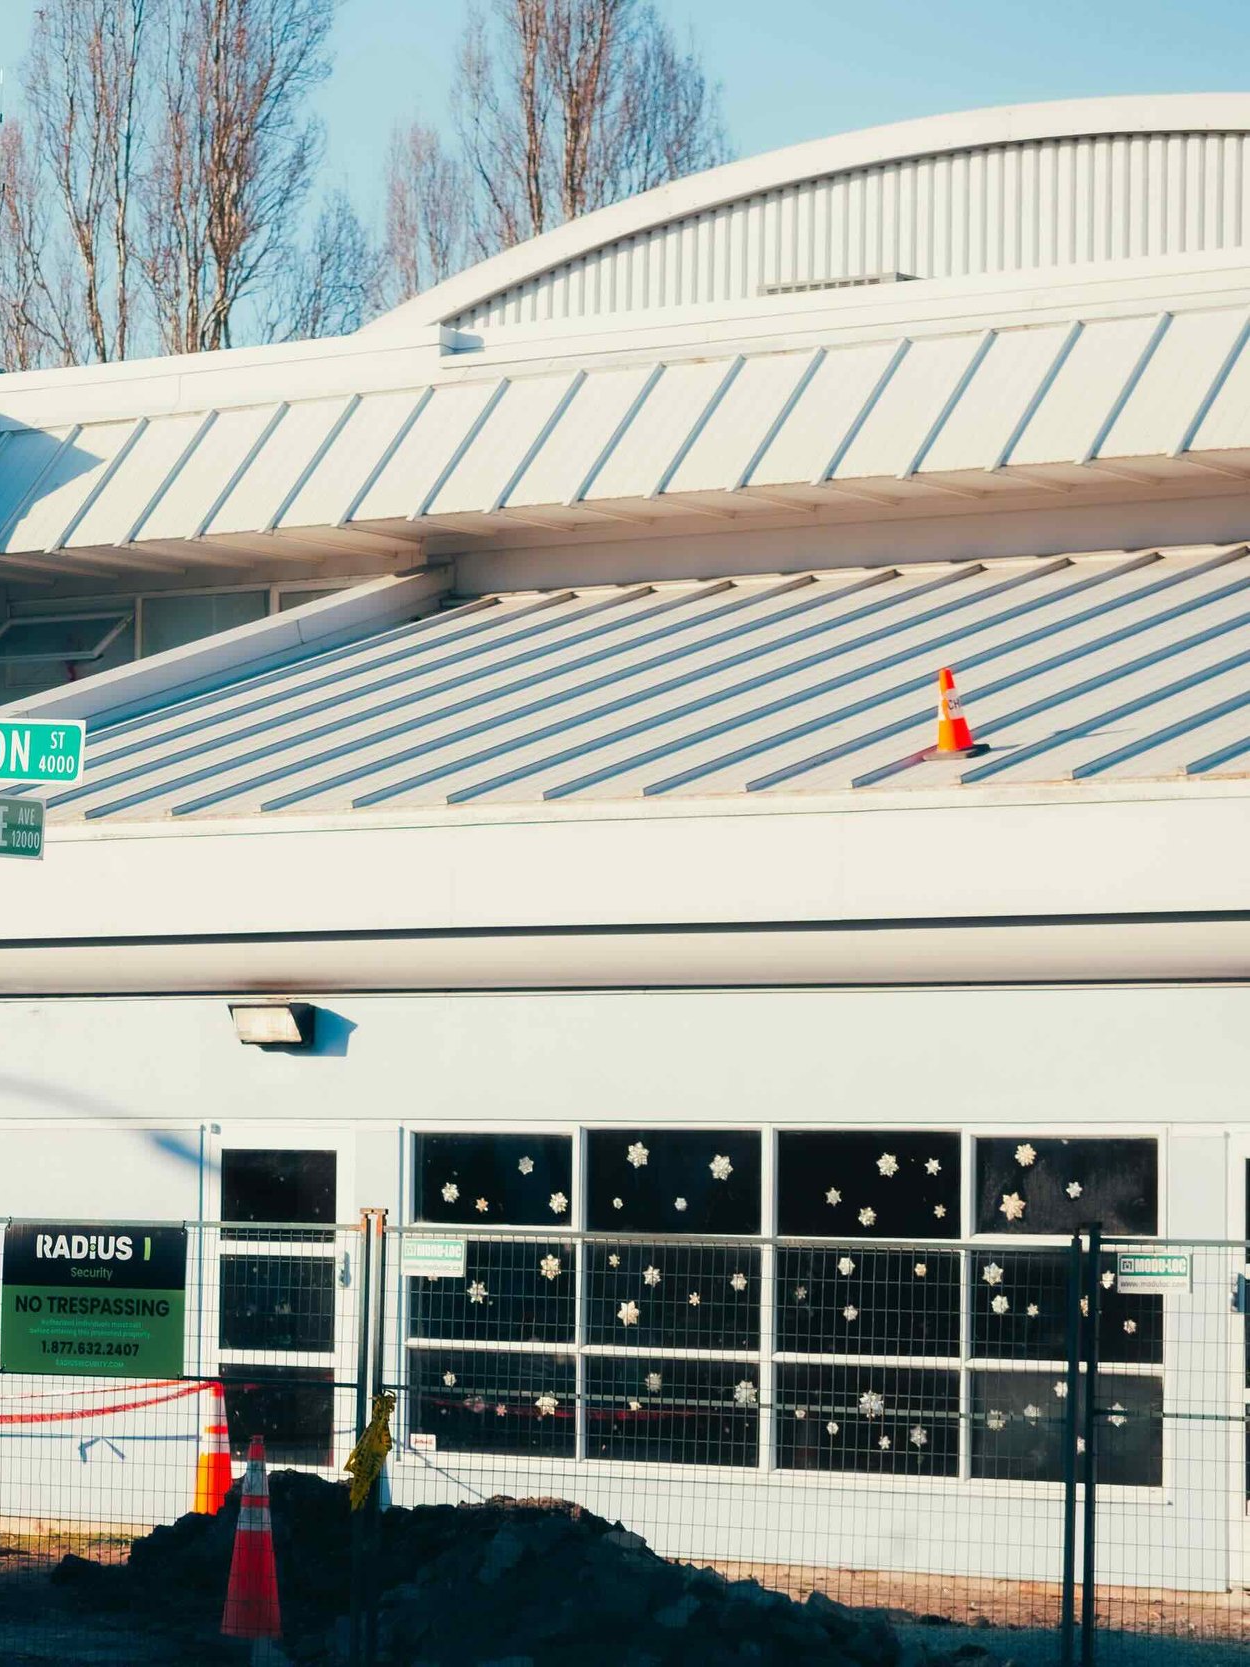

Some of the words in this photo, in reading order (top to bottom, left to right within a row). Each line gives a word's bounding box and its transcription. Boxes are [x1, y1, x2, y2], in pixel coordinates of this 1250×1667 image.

[49, 731, 66, 750] ST
[38, 755, 75, 774] 4000
[17, 807, 36, 826] AVE
[11, 830, 40, 849] 12000
[36, 1234, 133, 1260] RADIUS
[70, 1267, 113, 1280] Security
[15, 1295, 42, 1313] NO
[46, 1296, 170, 1317] TRESPASSING
[41, 1340, 140, 1357] 1.877.632.2407
